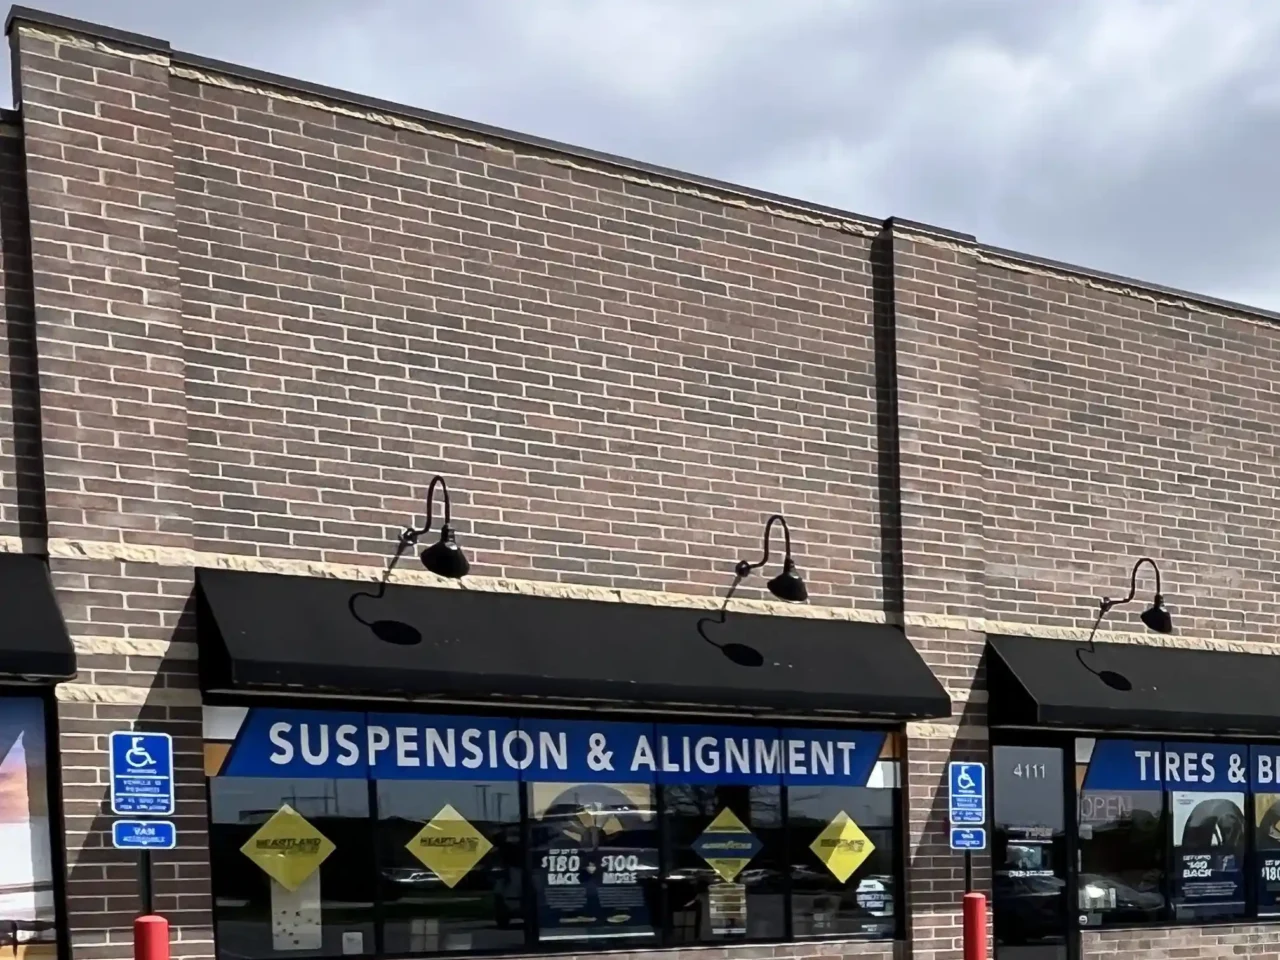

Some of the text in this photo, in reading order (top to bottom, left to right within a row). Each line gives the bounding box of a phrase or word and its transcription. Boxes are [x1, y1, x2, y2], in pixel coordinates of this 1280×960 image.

[269, 721, 857, 776] SUSPENSION & ALIGNMENT
[1013, 763, 1046, 779] 4111
[1134, 749, 1216, 784] TIRES
[1227, 753, 1247, 783] &
[1080, 796, 1132, 818] OPEN
[133, 827, 156, 836] VAN
[600, 854, 639, 872] $100
[1182, 868, 1212, 878] BACK
